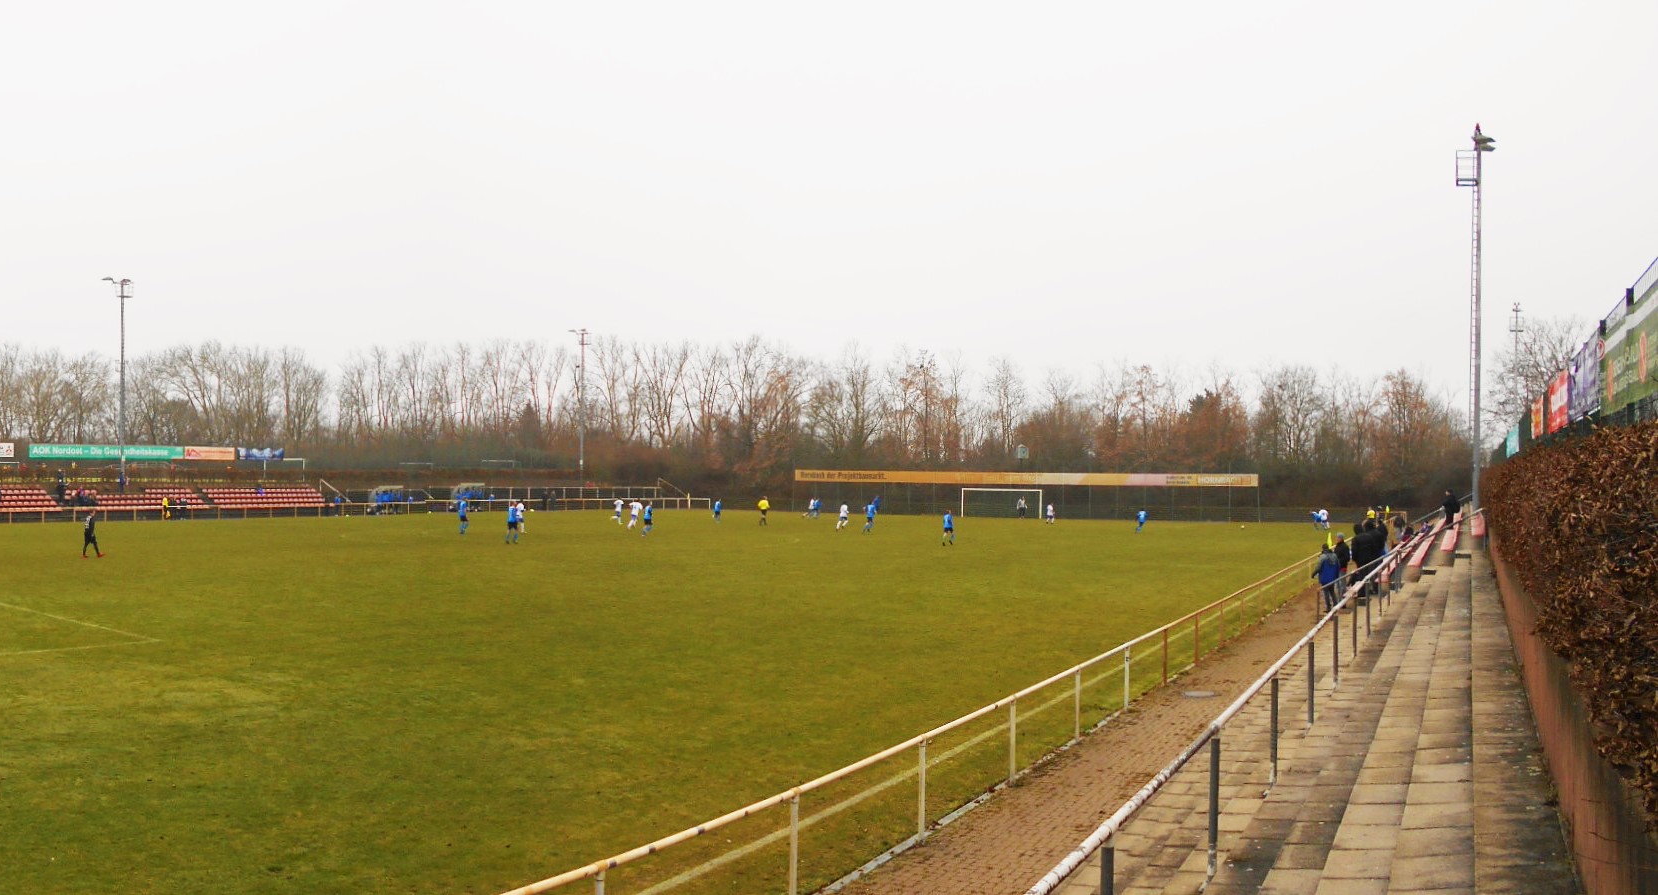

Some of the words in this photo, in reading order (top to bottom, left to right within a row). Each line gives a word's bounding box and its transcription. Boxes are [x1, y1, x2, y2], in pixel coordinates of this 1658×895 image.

[32, 446, 50, 455] AOK
[52, 446, 83, 455] Nordost
[90, 447, 102, 456] Die
